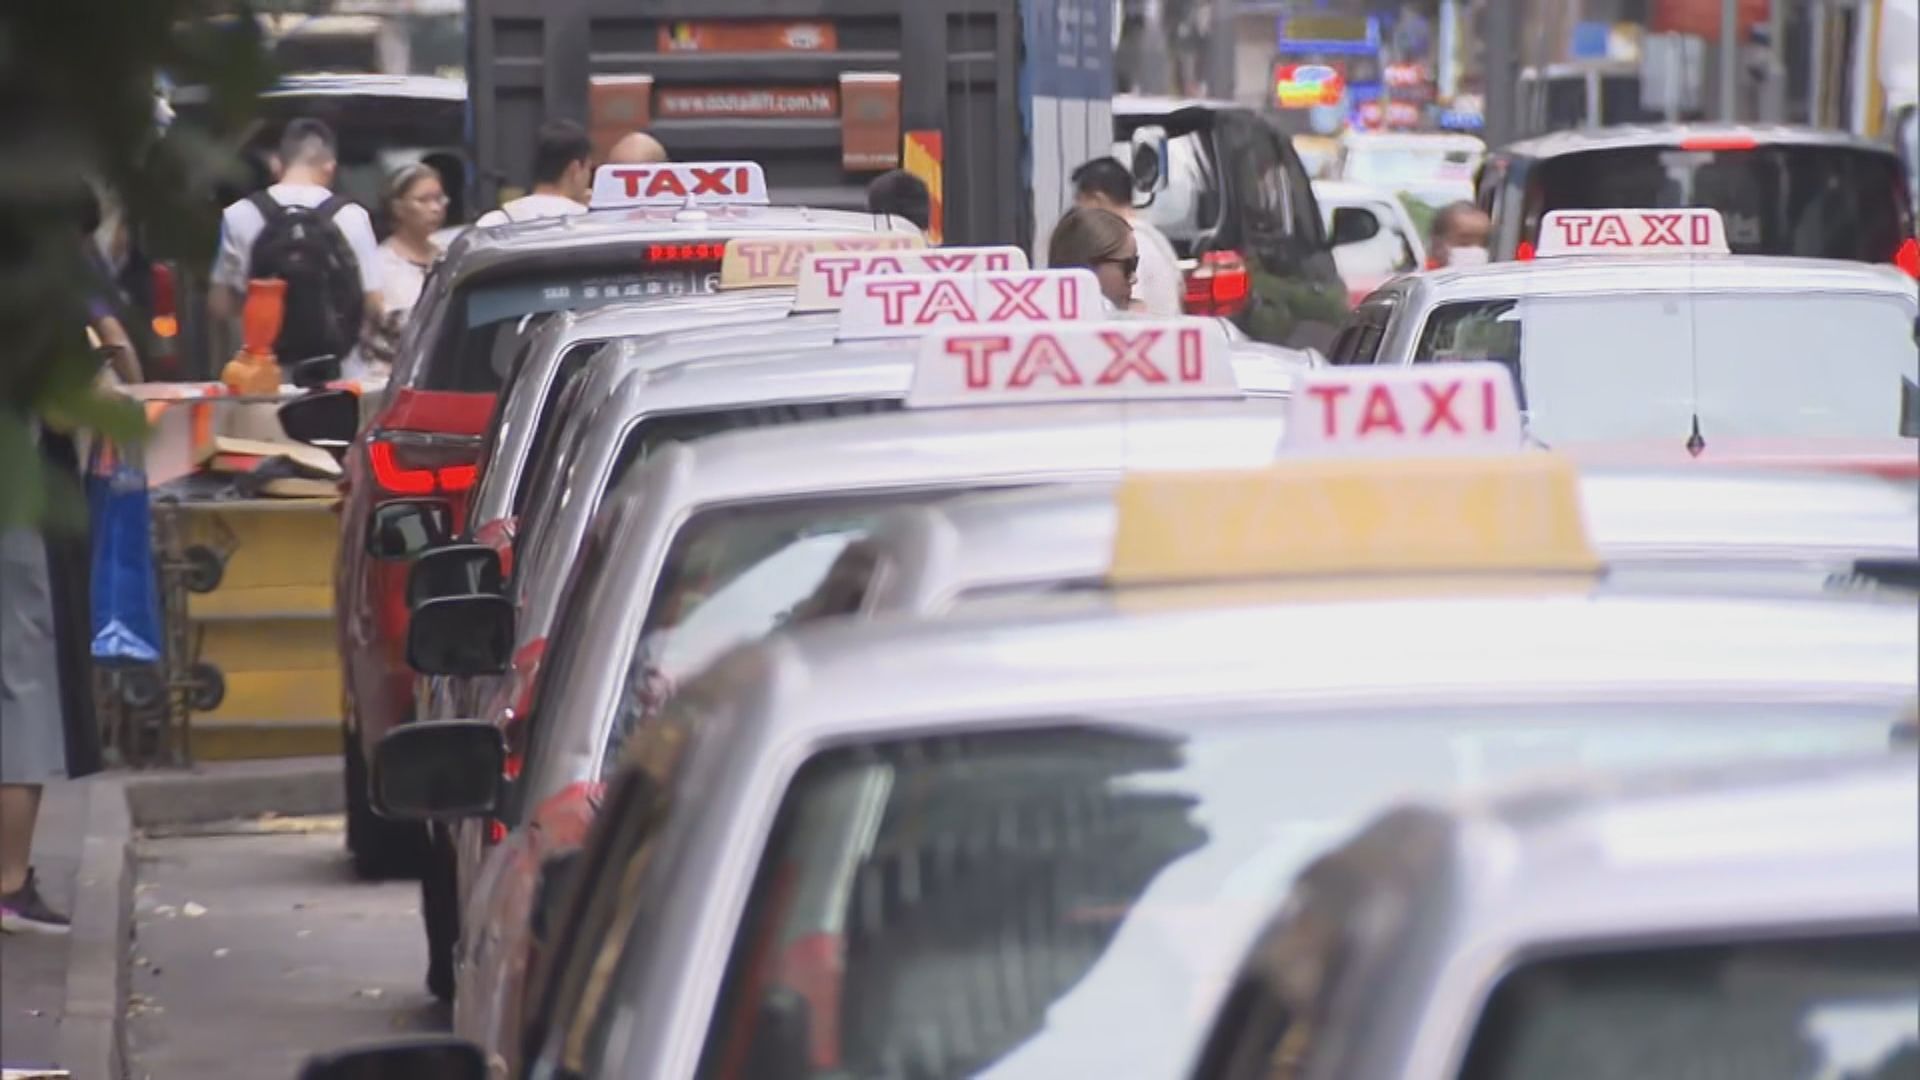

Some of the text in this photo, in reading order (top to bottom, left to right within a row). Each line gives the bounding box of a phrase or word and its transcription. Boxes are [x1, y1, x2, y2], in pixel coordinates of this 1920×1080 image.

[611, 167, 749, 198] TAXI
[1556, 214, 1710, 246] TAXI
[738, 237, 912, 277] TA
[866, 276, 1078, 326] TAXI
[944, 328, 1206, 390] TAXI
[1306, 381, 1498, 437] TAXI
